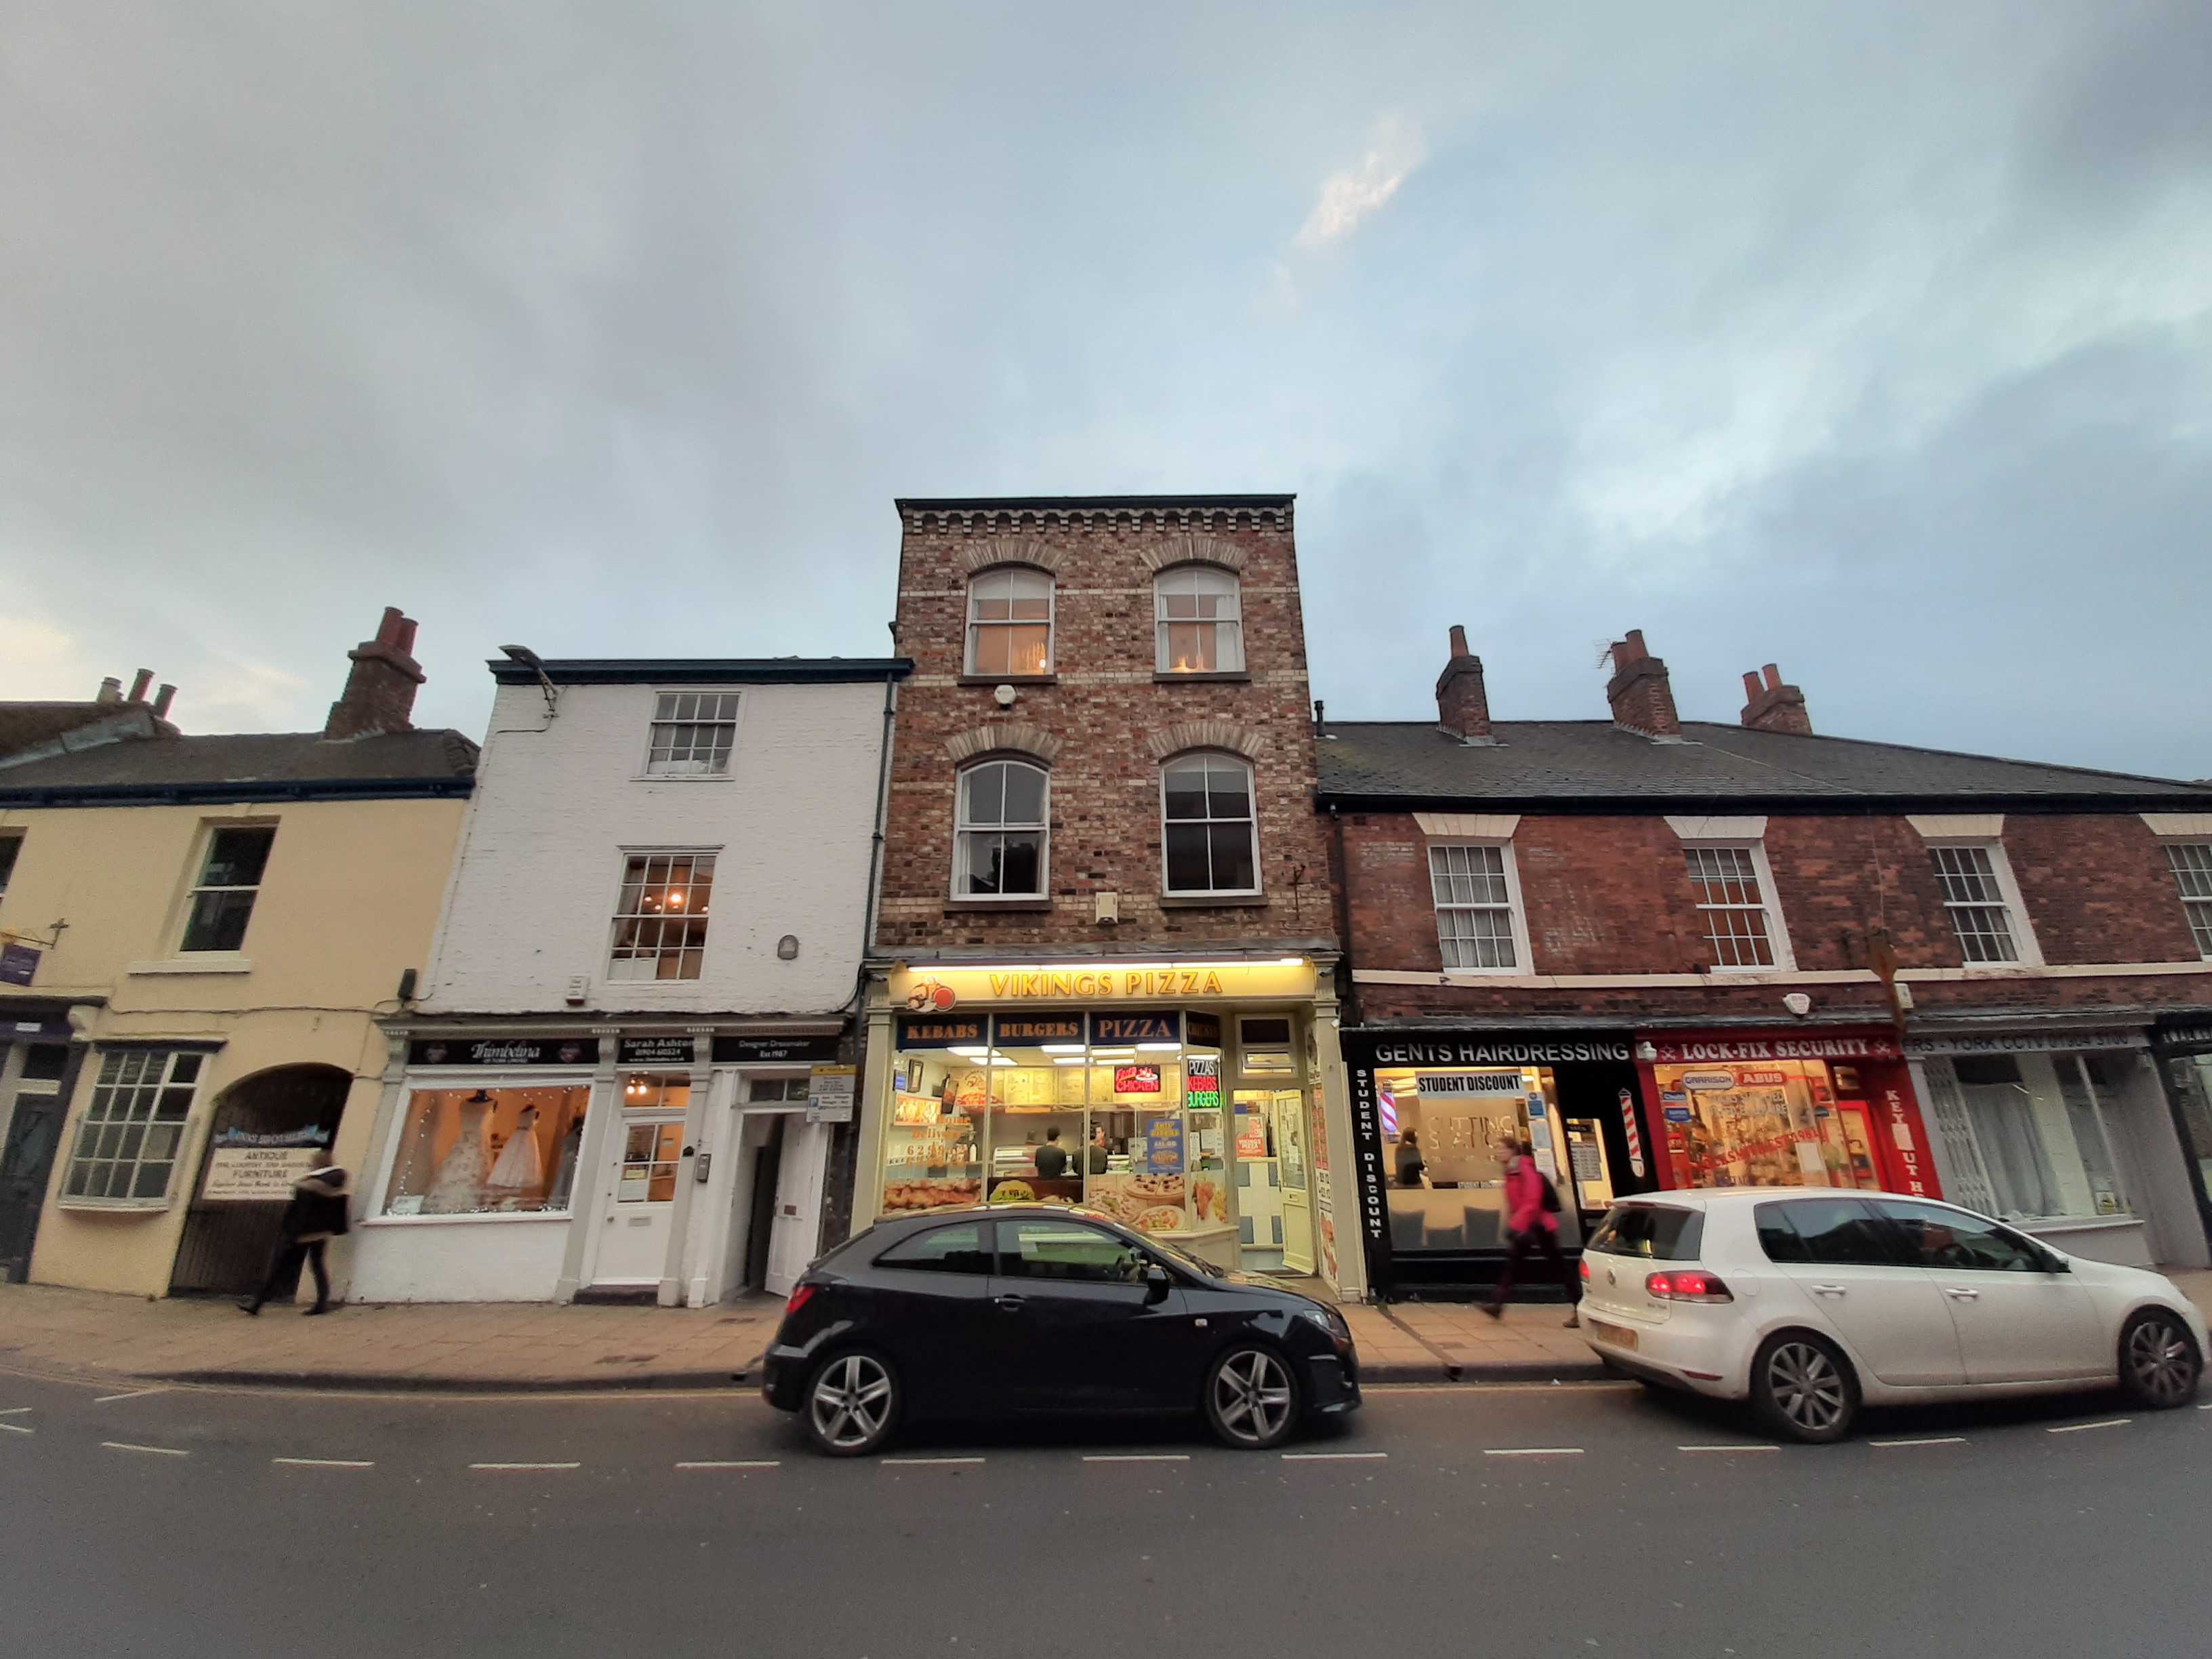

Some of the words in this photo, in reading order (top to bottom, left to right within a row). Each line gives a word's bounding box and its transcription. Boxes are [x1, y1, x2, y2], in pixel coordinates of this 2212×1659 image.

[989, 973, 1113, 996] VIKINGS
[1126, 971, 1223, 994] PIZZA
[907, 1024, 979, 1040] KEBABS
[1000, 1023, 1079, 1038] BURGERS
[1099, 1019, 1172, 1038] PIZZA
[624, 1039, 655, 1048] Sarah
[1681, 1042, 1774, 1061] LOCK-FIX
[1774, 1038, 1869, 1058] SECURITY
[1948, 1036, 1998, 1050] YORK
[1376, 1044, 1453, 1062] GENTS
[1460, 1042, 1629, 1061] HAIRDRESSING
[1189, 1060, 1214, 1075] PIZZAS
[1115, 1080, 1160, 1092] CHICKEN
[1187, 1076, 1218, 1091] KEBABS
[1418, 1075, 1465, 1092] STUDENT
[1467, 1074, 1521, 1091] DISCOUNT
[1685, 1076, 1732, 1084] GARRISON
[1743, 1073, 1783, 1084] ABUS
[1187, 1091, 1219, 1107] BURGERS
[1357, 1069, 1373, 1140] STUDENT
[1428, 1115, 1515, 1136] CUTTING
[1364, 1153, 1381, 1239] DISCOUNT
